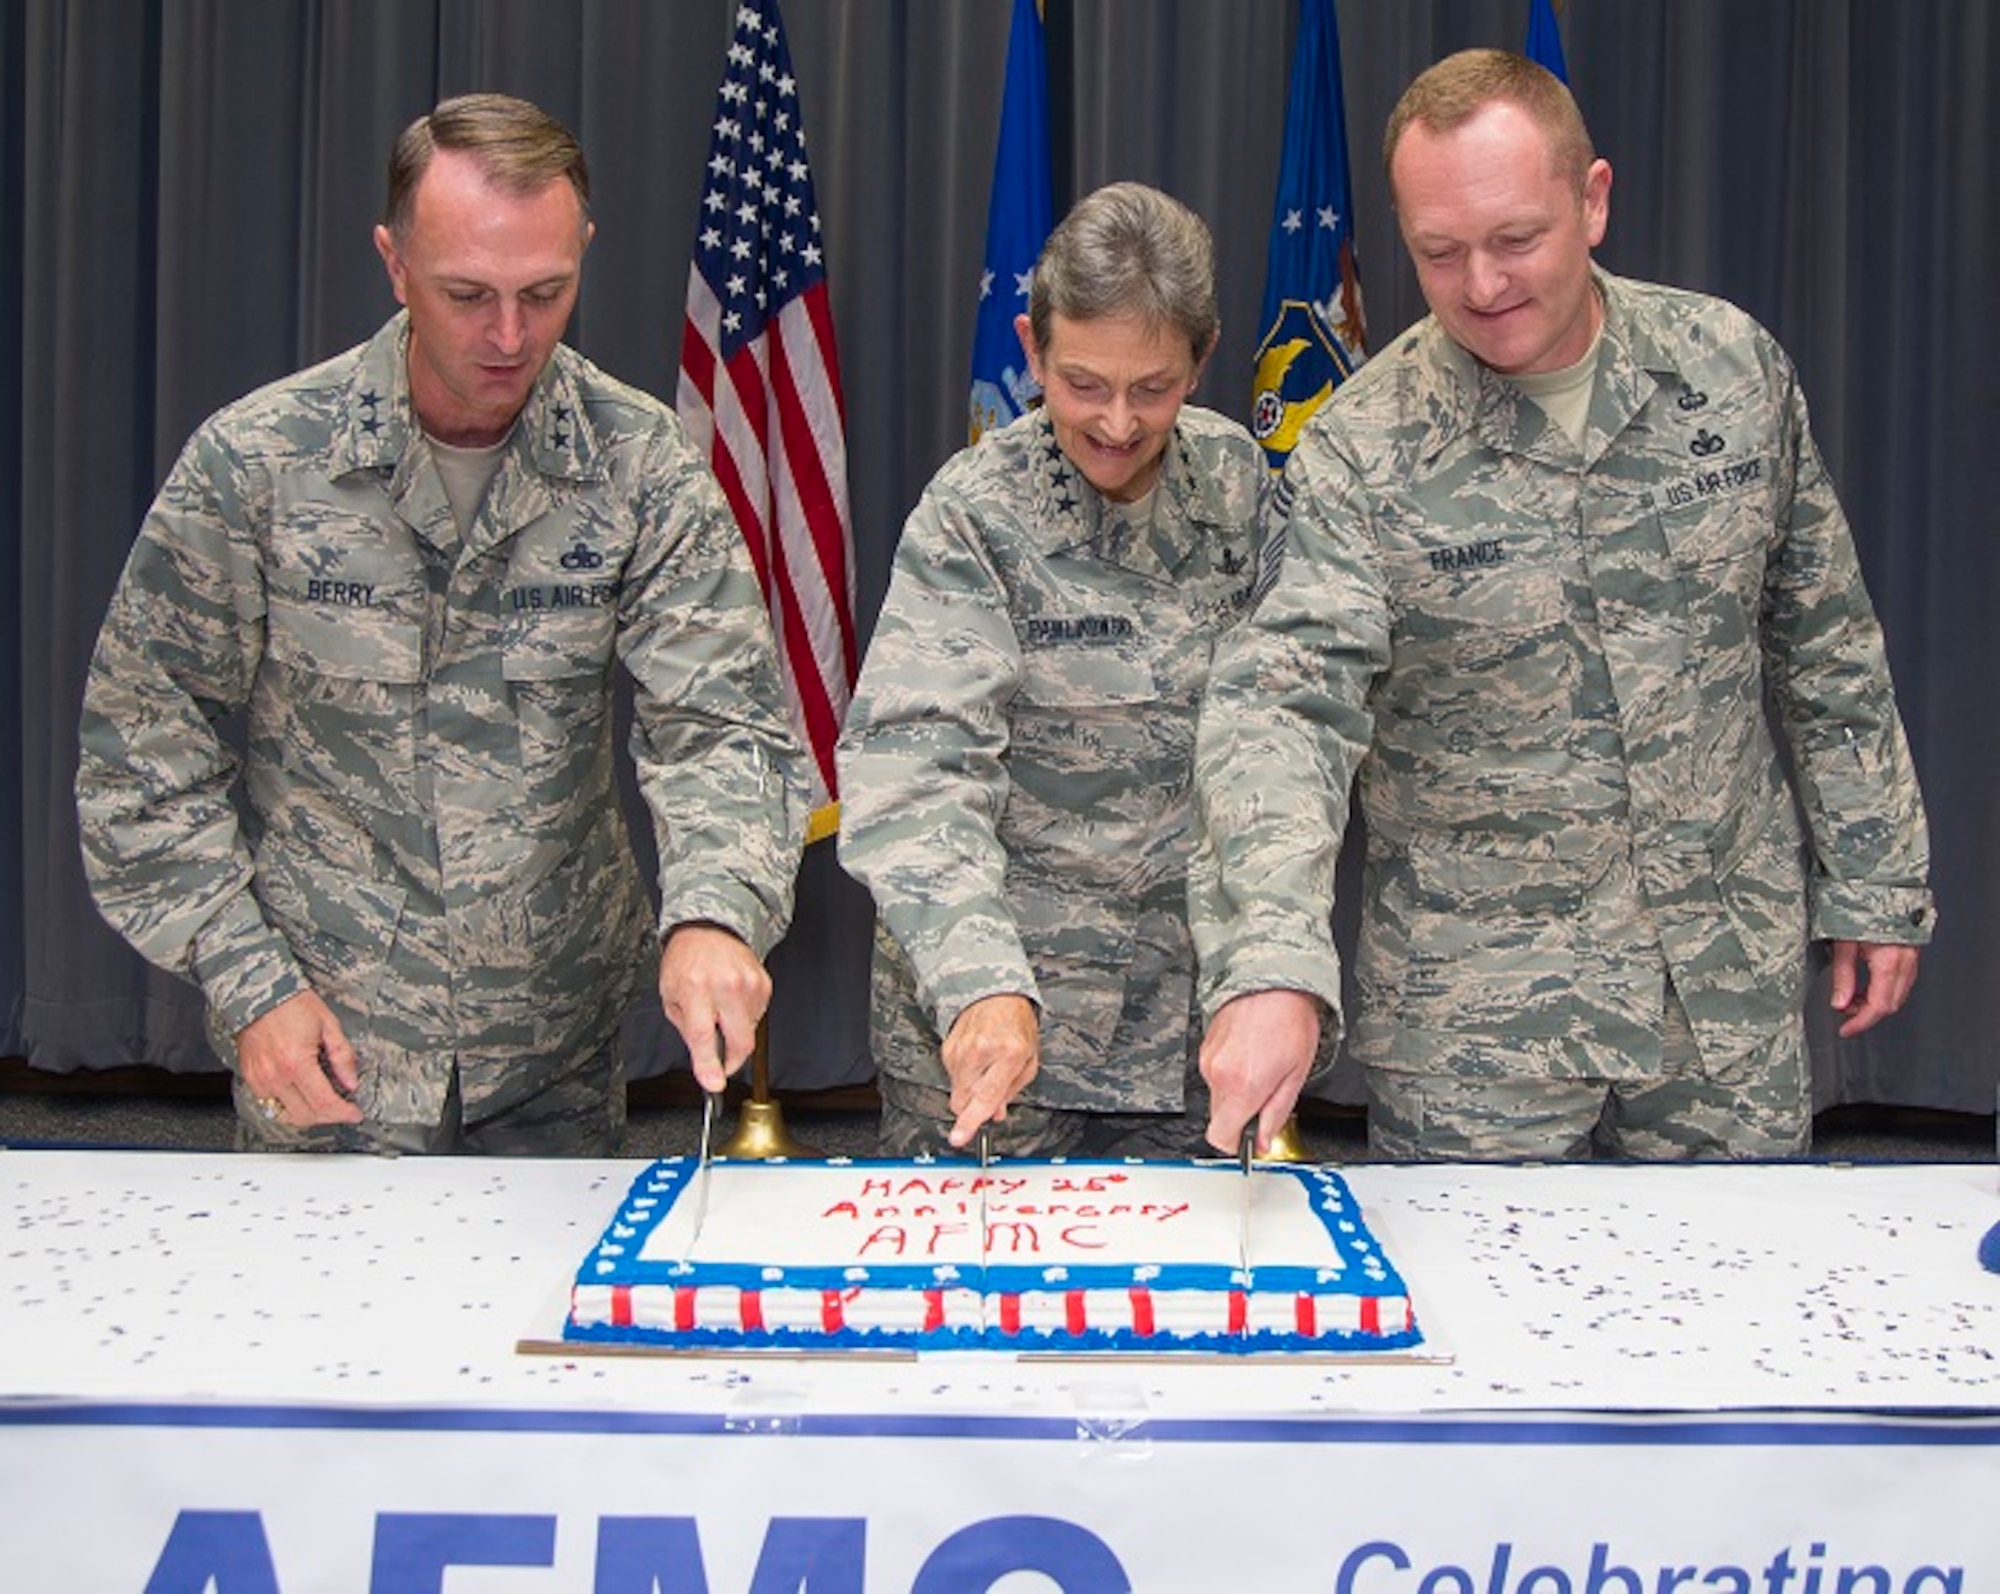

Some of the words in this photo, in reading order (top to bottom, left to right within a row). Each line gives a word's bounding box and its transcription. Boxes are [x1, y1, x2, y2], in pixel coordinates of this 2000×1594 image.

[1429, 540, 1506, 571] FRANCE
[308, 580, 375, 607] BERRY
[551, 585, 584, 607] AIR
[857, 1222, 1110, 1257] AFMC
